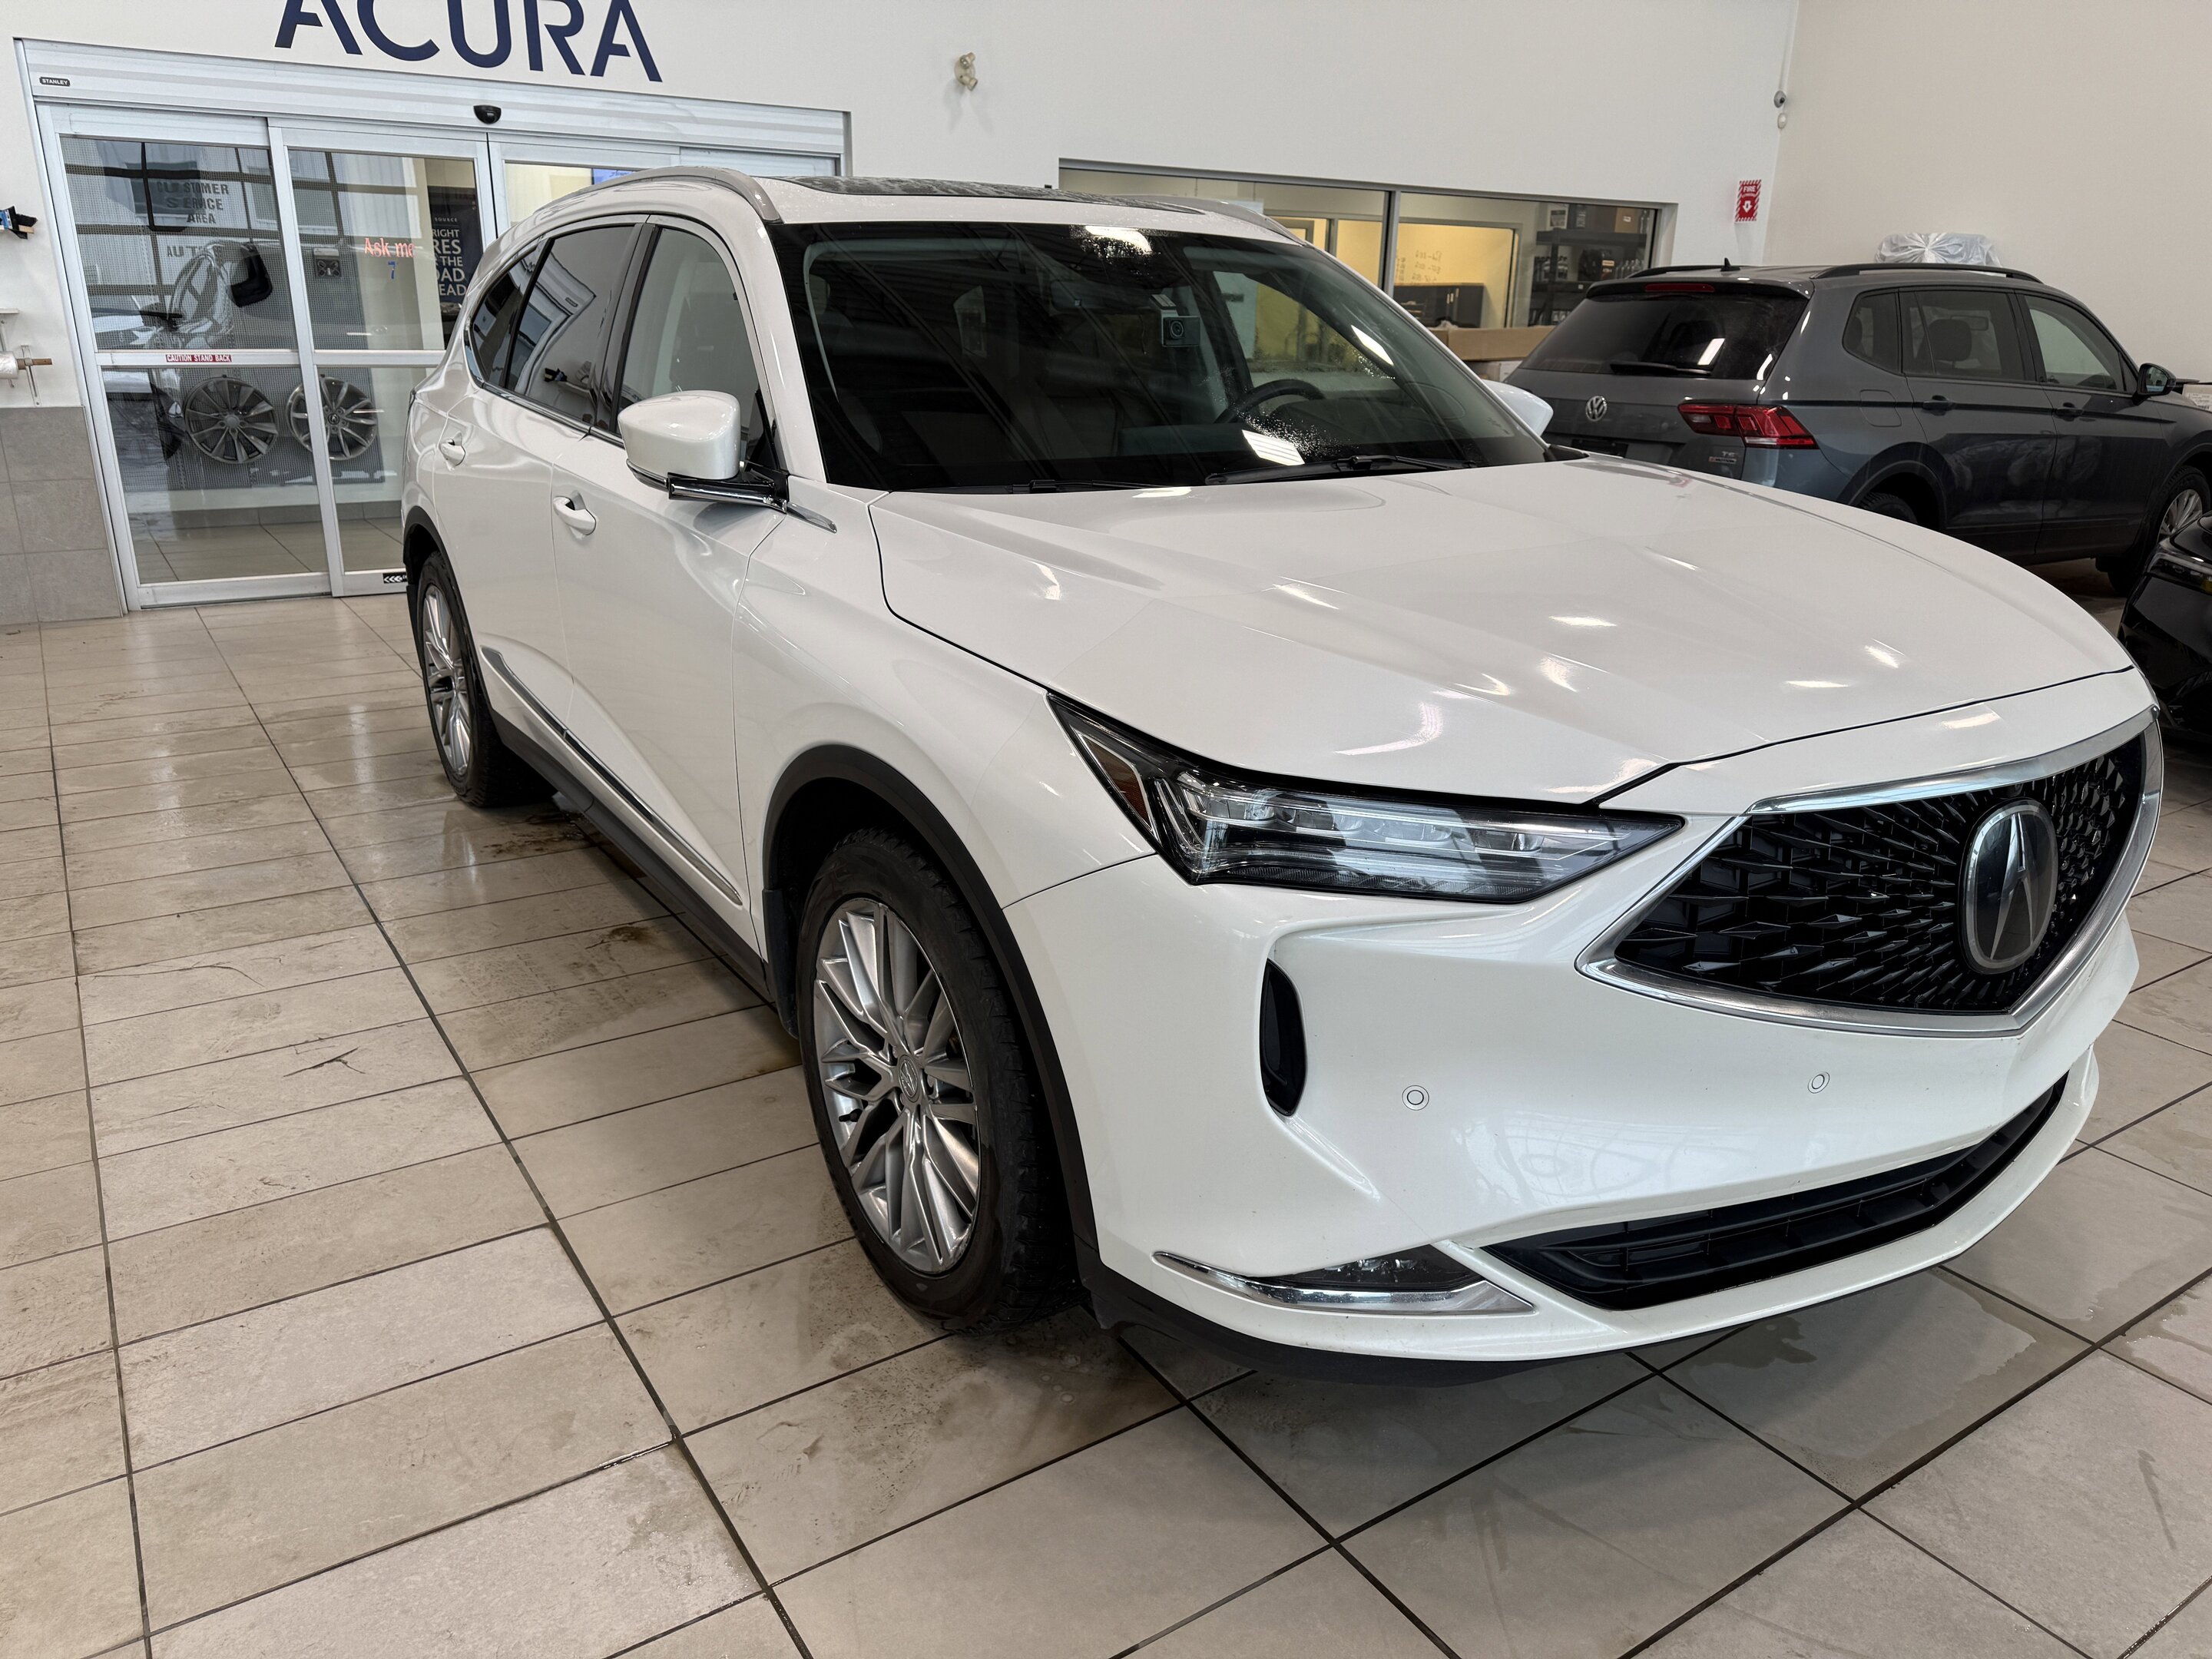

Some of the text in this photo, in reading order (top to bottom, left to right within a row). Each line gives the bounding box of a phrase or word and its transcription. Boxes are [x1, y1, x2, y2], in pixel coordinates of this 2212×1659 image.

[274, 0, 663, 82] ACURA
[432, 229, 460, 237] RIGHT
[364, 237, 416, 258] Ask me
[433, 239, 462, 254] RES
[439, 256, 463, 267] THE
[436, 267, 465, 282] AD
[439, 283, 467, 296] EAD
